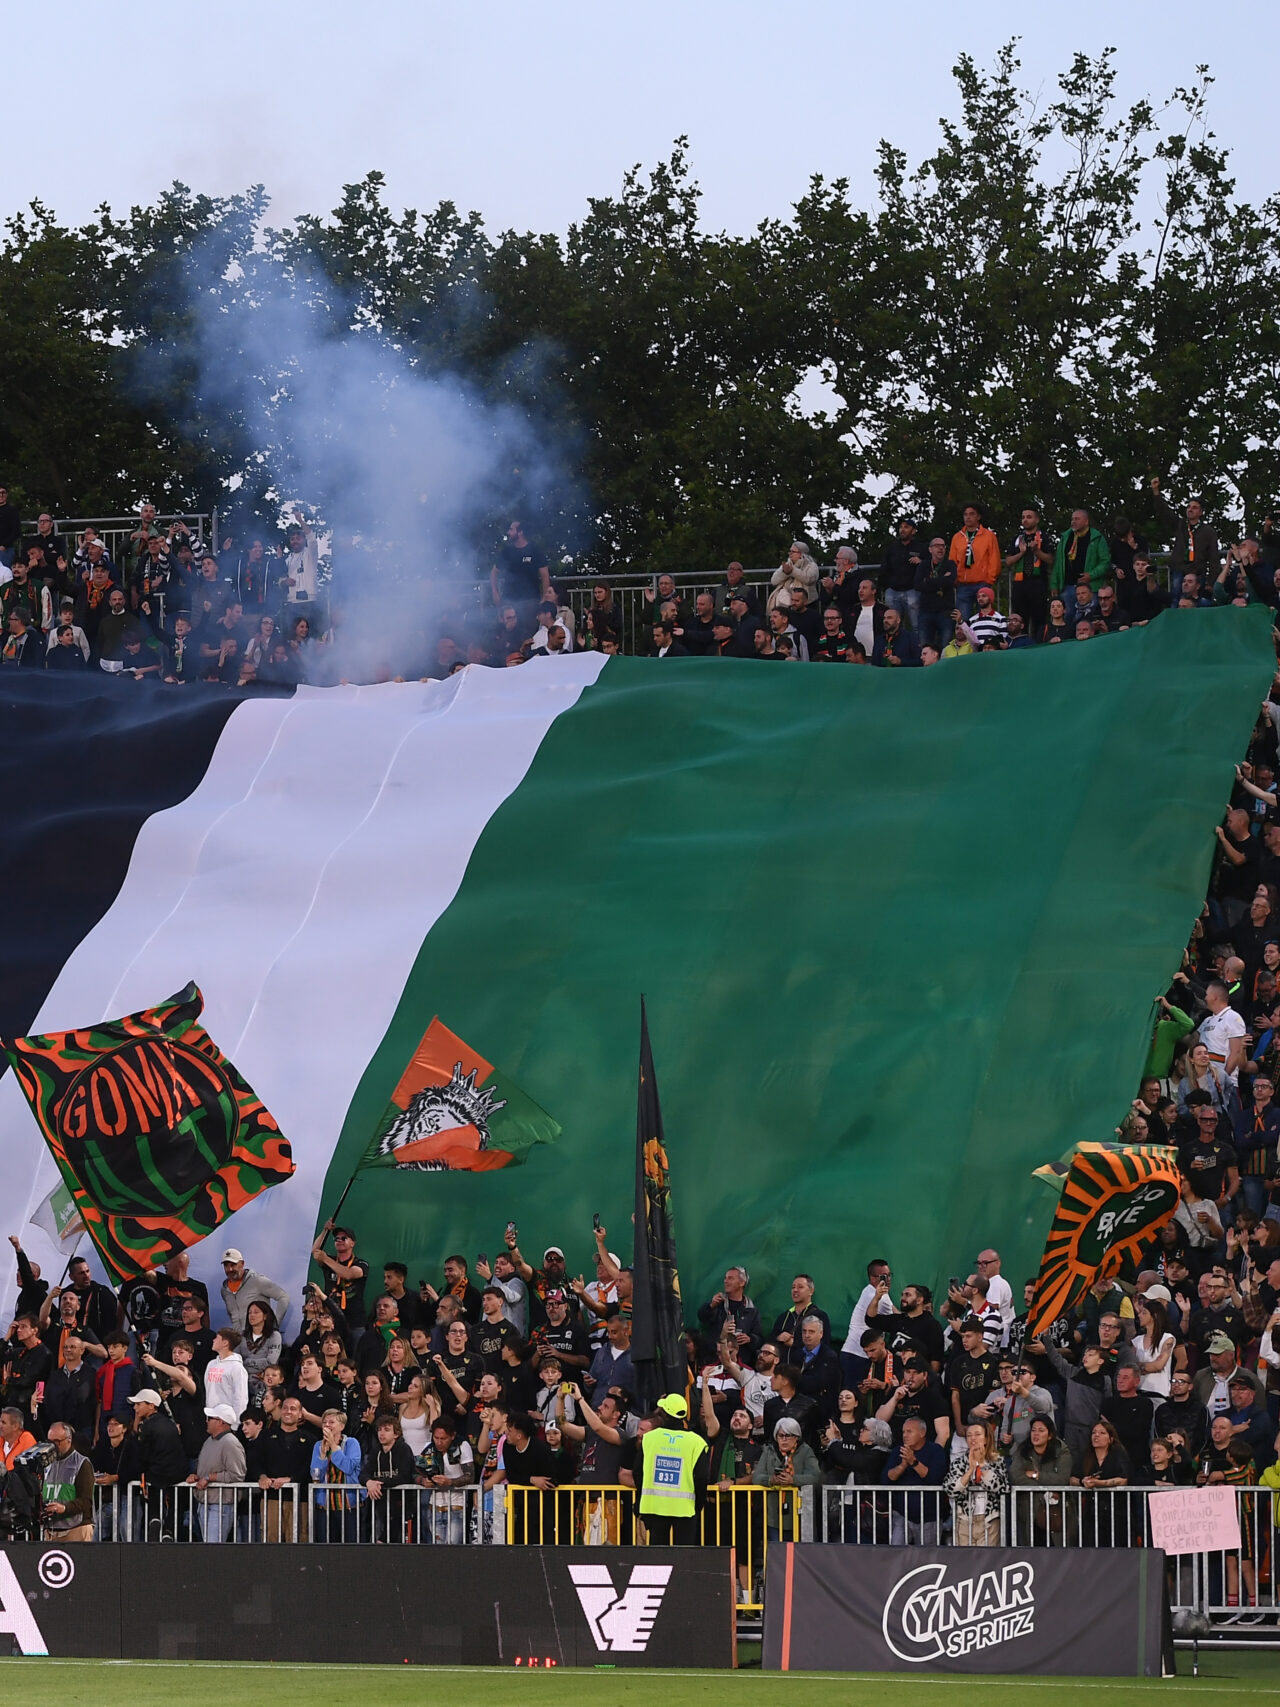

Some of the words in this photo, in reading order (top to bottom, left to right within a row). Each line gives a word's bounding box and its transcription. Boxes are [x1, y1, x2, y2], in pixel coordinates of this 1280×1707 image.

[656, 1459, 680, 1469] STEWARD
[658, 1472, 674, 1482] 833
[46, 1484, 62, 1500] TV
[882, 1561, 1035, 1663] CYNAR
[946, 1606, 1035, 1658] SPRITZ
